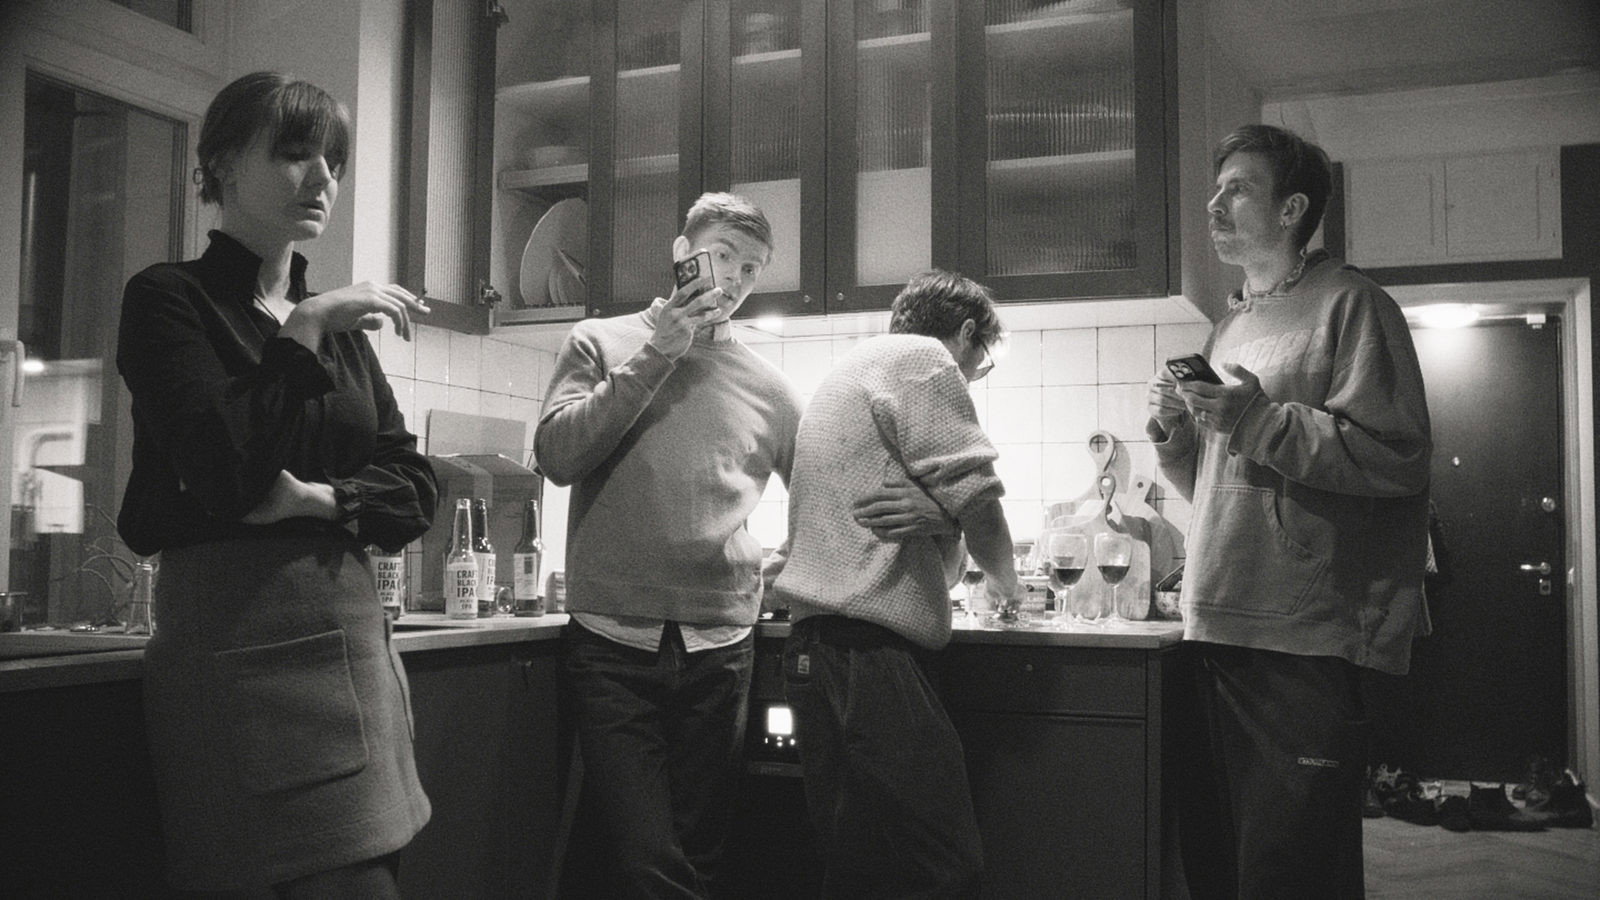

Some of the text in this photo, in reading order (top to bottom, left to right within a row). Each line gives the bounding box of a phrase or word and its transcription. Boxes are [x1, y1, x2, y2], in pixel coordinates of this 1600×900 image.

[456, 569, 478, 579] CRAFT
[377, 579, 396, 590] IPA
[456, 587, 475, 598] IPA
